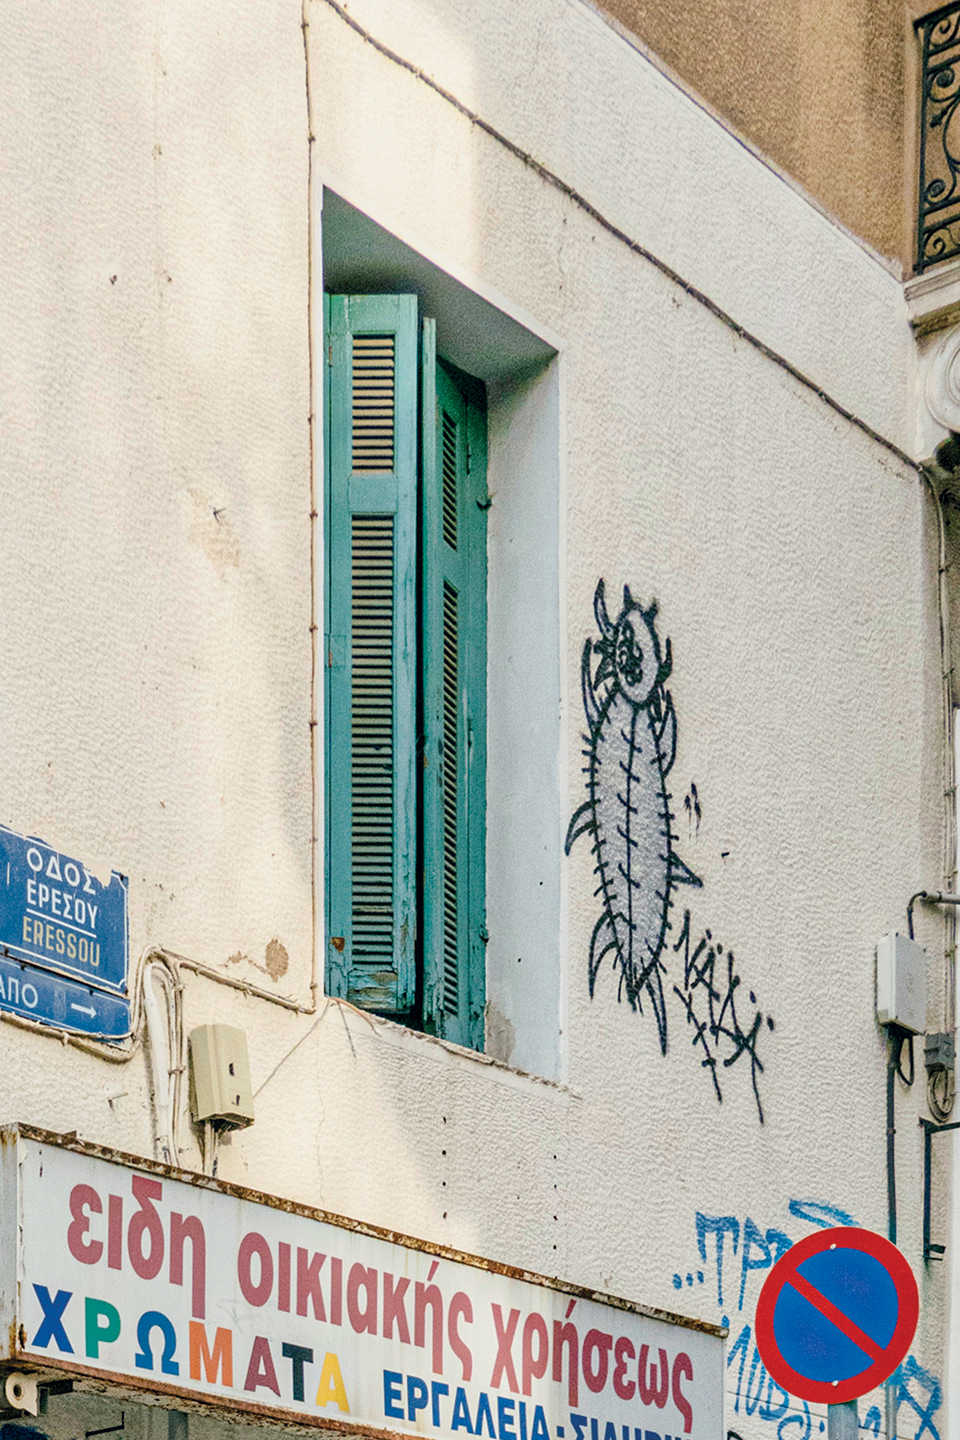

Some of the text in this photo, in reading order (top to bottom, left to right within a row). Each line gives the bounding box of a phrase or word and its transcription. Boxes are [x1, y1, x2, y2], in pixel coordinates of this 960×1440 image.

[26, 848, 96, 895] ΟΔΟΣ
[26, 878, 98, 929] ΕΡΕΣΟΥ
[22, 915, 101, 967] ERESSOU
[67, 1174, 207, 1319] ειδη
[237, 1231, 474, 1382] οικιακής
[31, 1283, 350, 1413] ΧΡΩΜΑΤΑ
